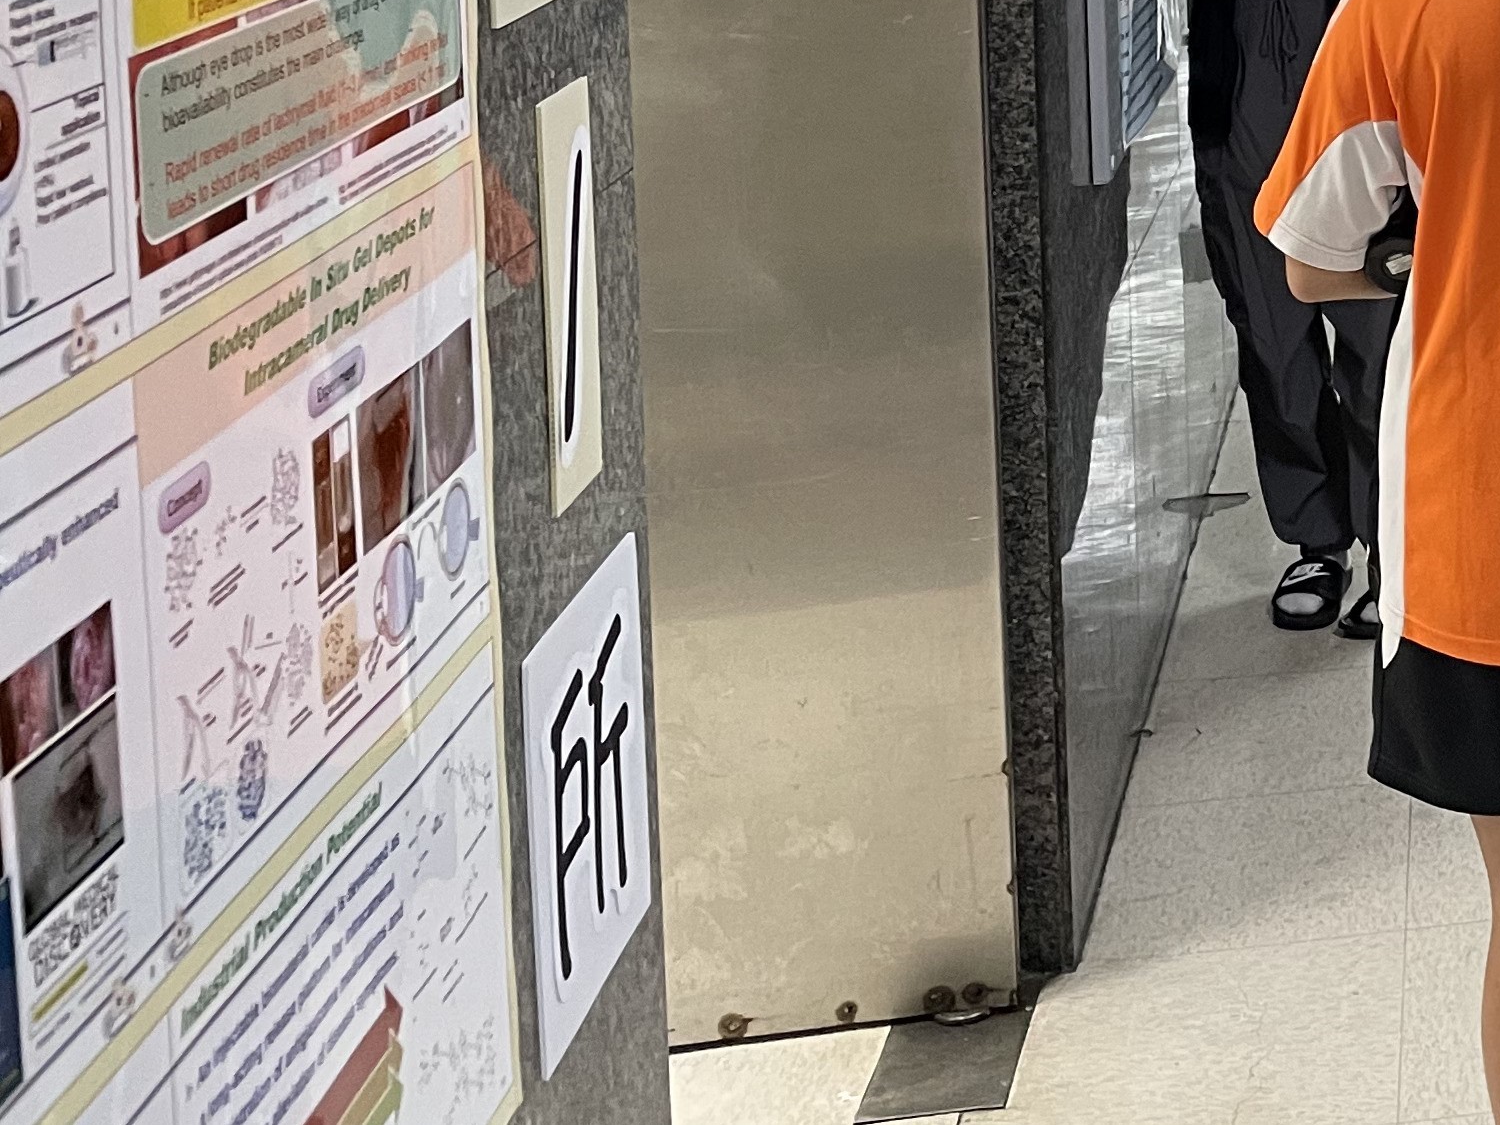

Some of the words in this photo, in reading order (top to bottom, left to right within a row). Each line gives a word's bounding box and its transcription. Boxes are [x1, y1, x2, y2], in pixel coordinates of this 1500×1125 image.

[208, 285, 307, 371] Biodegradable
[309, 276, 322, 302] In
[326, 261, 350, 292] Situ
[353, 237, 375, 273] Gel
[375, 216, 417, 260] Depots
[418, 205, 437, 232] for
[243, 313, 329, 398] Intracameral
[331, 296, 360, 335] Drug
[361, 264, 412, 314] Delivery
